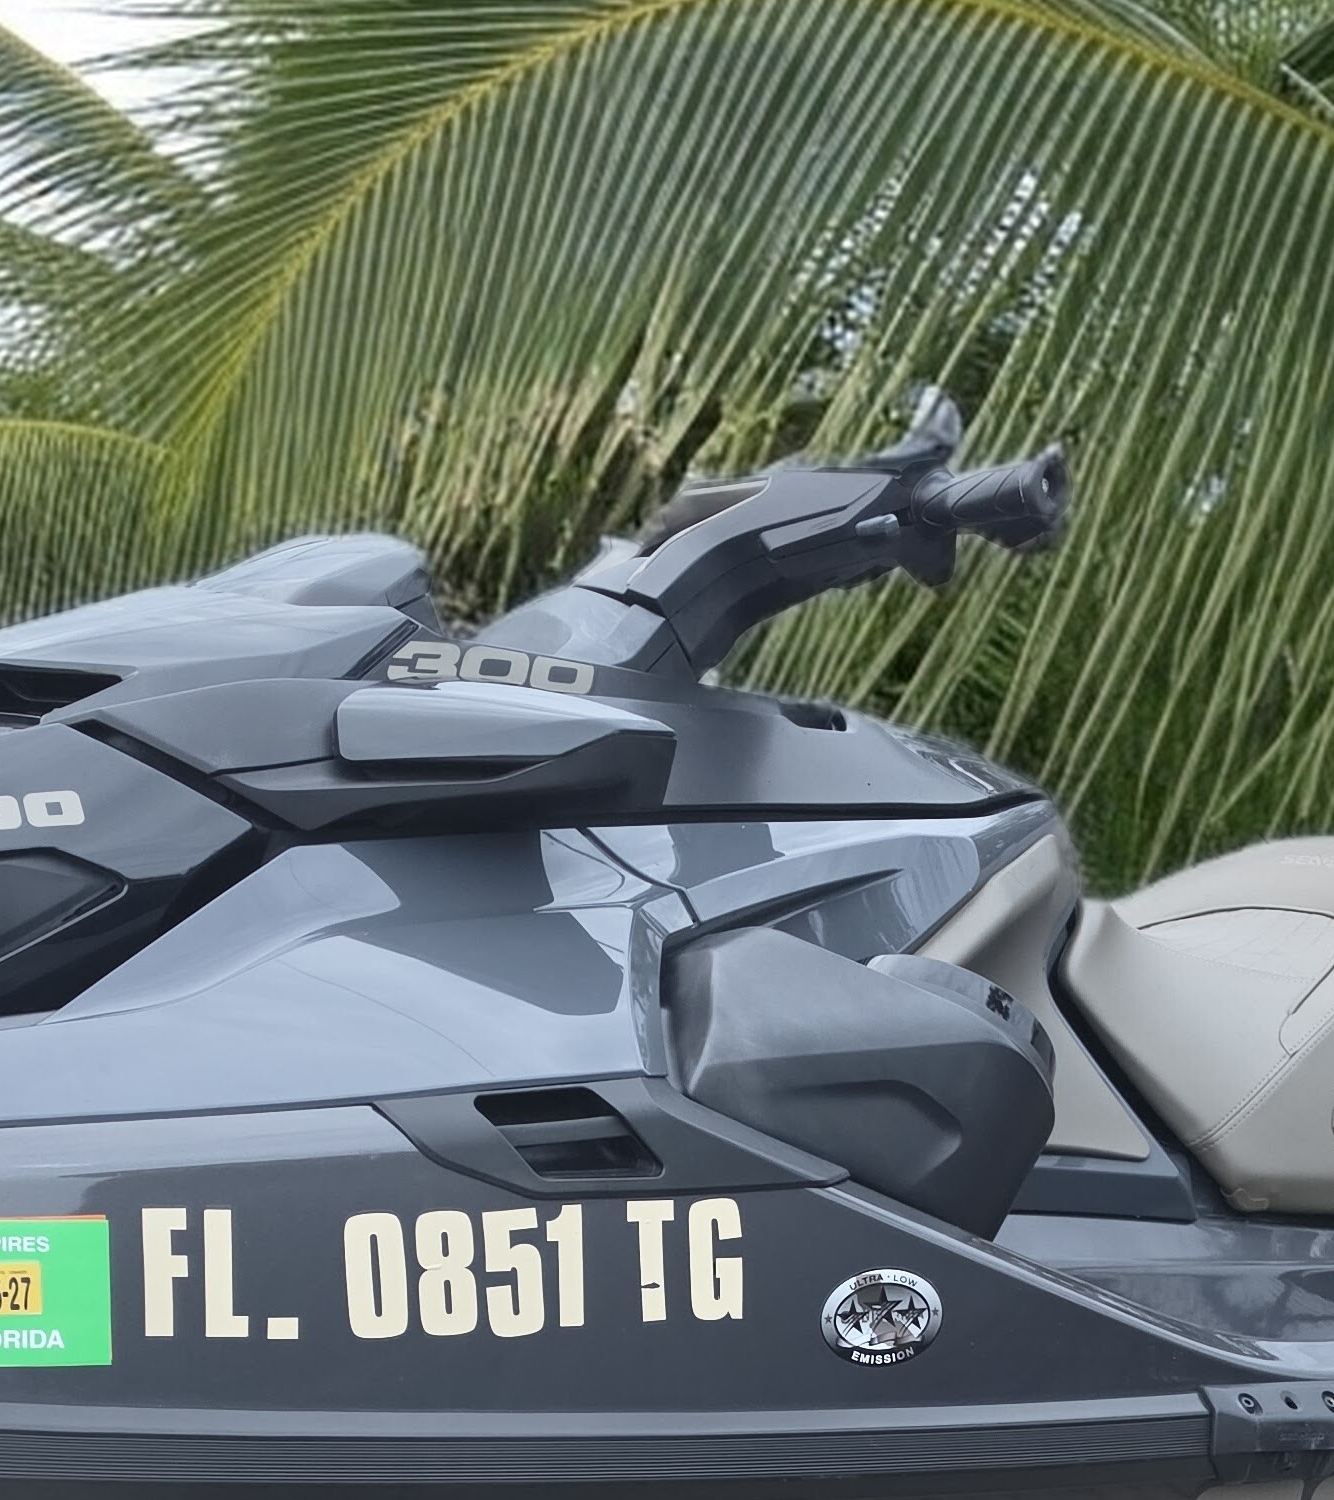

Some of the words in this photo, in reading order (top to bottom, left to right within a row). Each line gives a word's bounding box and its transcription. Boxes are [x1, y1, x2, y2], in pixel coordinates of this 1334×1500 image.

[387, 640, 595, 694] 300
[343, 1203, 585, 1338] 0851
[626, 1197, 743, 1323] TG
[849, 1273, 884, 1291] ULTRA
[893, 1274, 918, 1287] LOW
[851, 1346, 915, 1365] EMISSION
